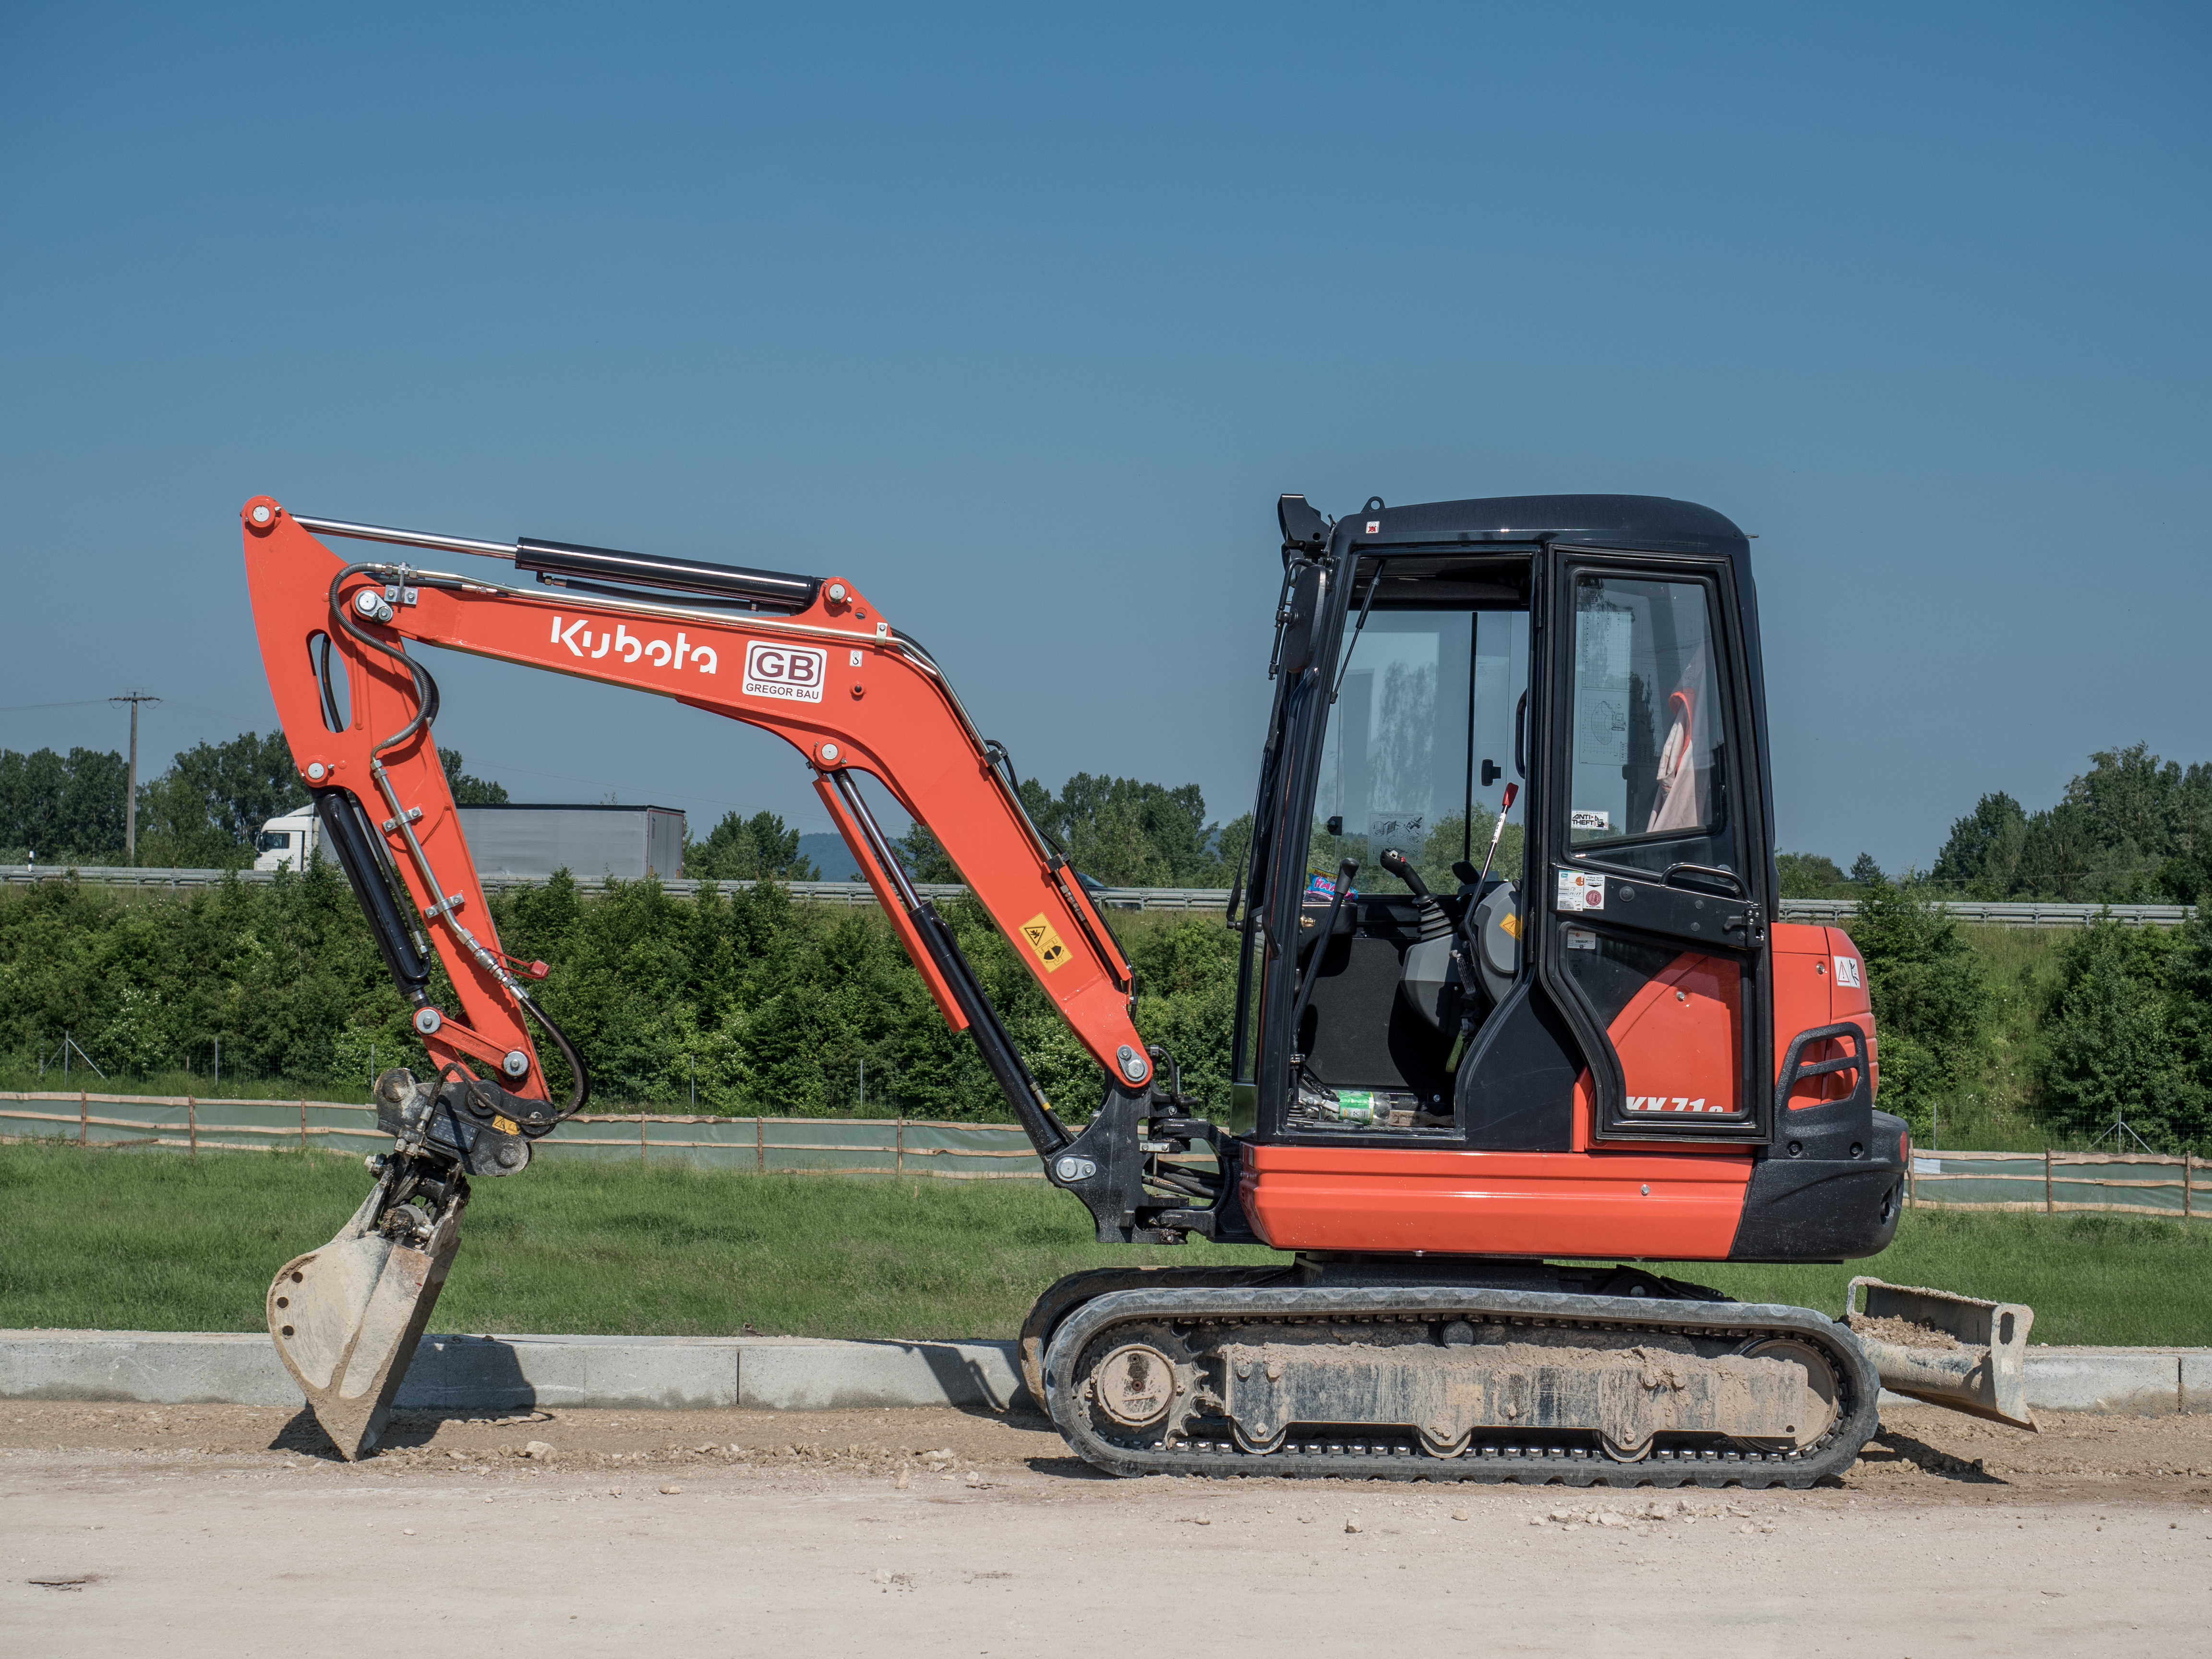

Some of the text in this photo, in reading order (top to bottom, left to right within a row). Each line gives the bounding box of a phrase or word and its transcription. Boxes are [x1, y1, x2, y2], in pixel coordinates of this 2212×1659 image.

[550, 616, 718, 674] Kubota
[756, 651, 814, 681] GB
[746, 683, 819, 699] GREGOR BAU
